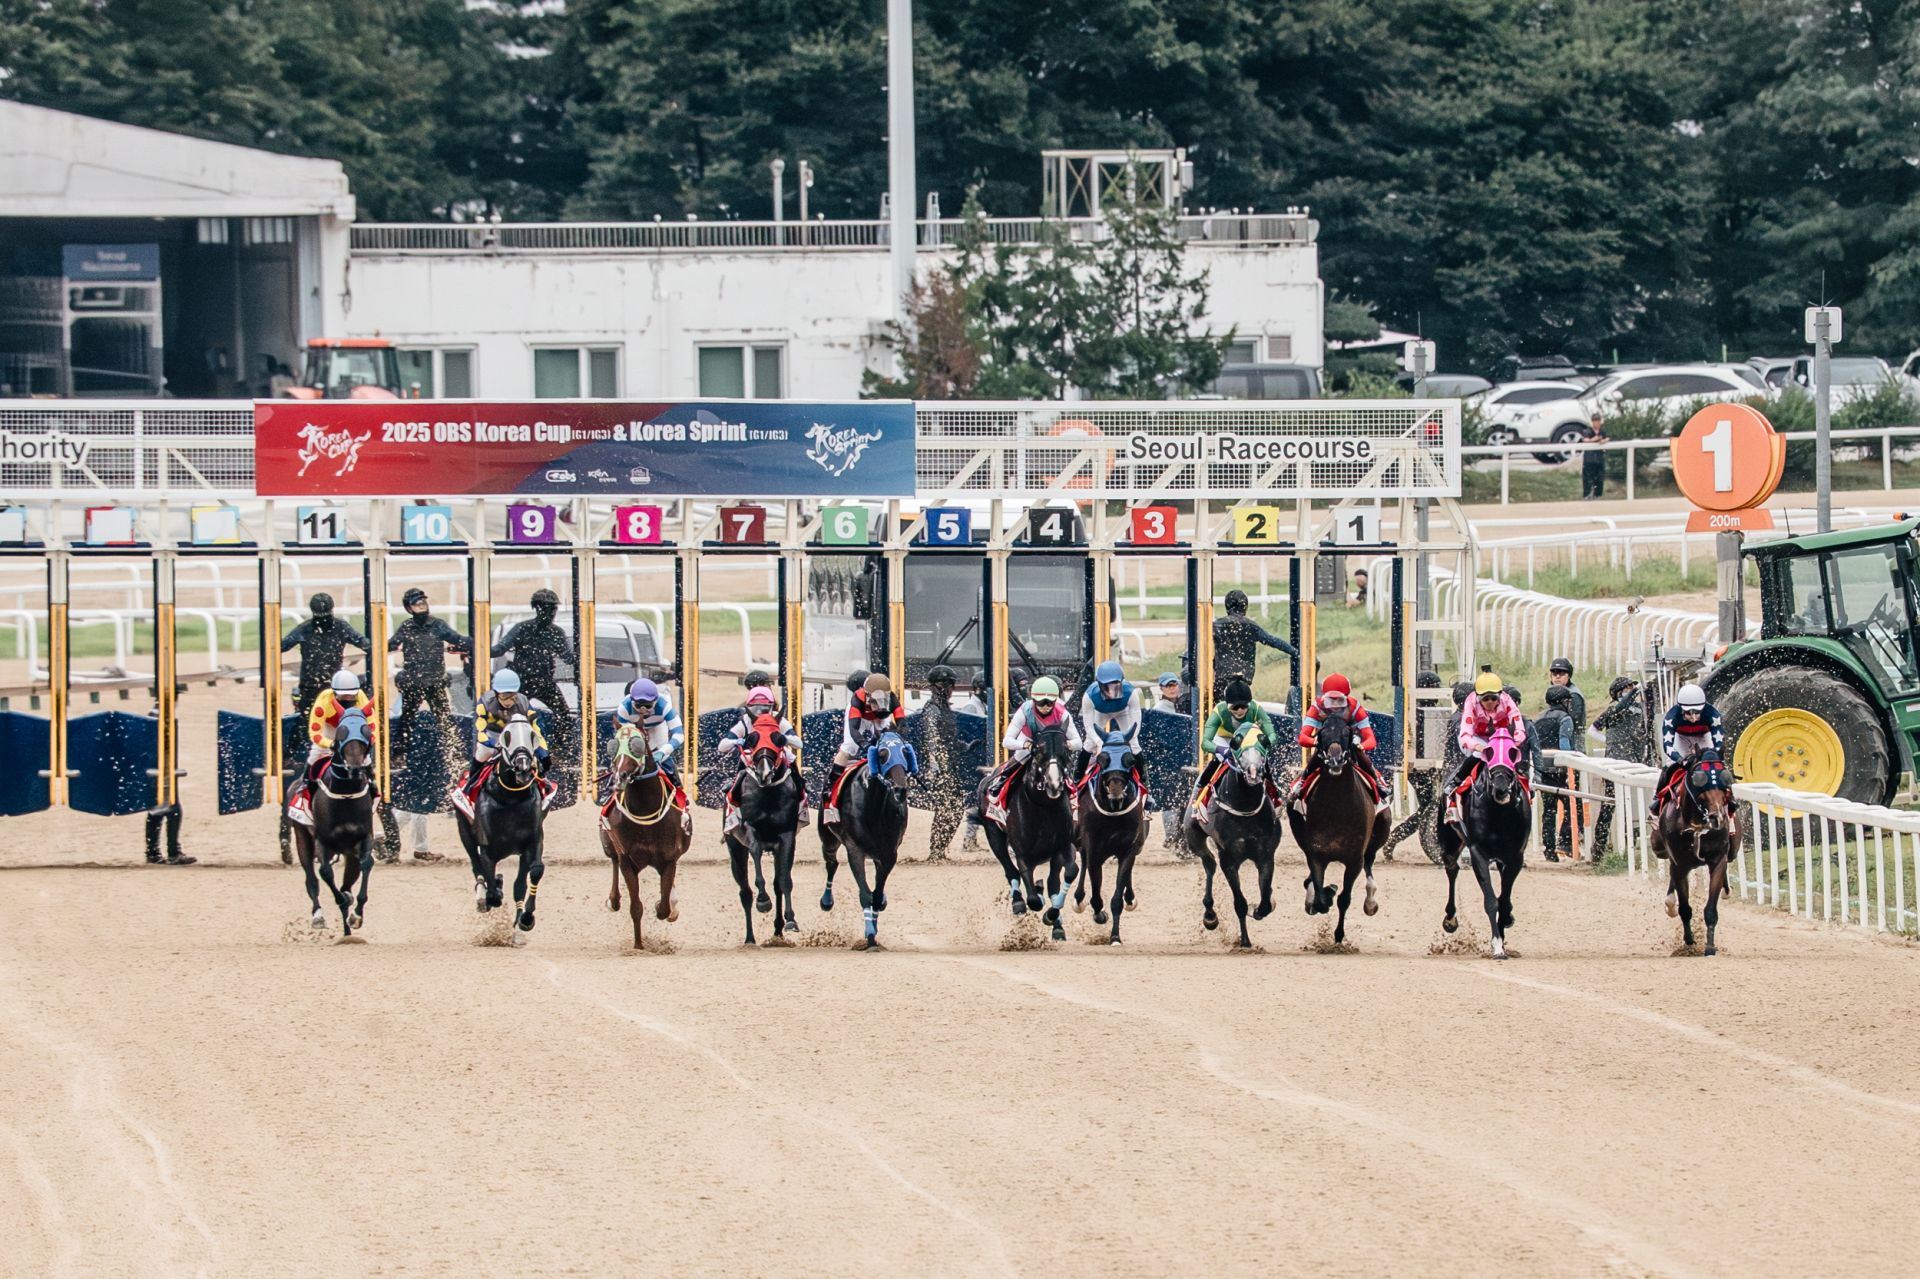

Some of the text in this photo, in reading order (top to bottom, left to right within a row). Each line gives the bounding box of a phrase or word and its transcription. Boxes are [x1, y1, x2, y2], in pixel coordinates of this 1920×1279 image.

[382, 421, 431, 443] 2025
[434, 421, 472, 443] OBS
[474, 421, 531, 442] Korea
[534, 421, 571, 444] Cup
[613, 424, 628, 442] &
[630, 421, 686, 442] Korea
[689, 420, 748, 443] Sprint
[2, 434, 87, 466] hority
[1131, 435, 1371, 461] Seoul Racecourse
[1701, 420, 1733, 492] 1
[302, 512, 337, 539] 11
[409, 512, 448, 540] 10
[521, 510, 546, 537] 9
[628, 511, 651, 539] 8
[732, 514, 755, 541] 7
[834, 511, 857, 539] 6
[937, 514, 960, 540] 5
[1038, 513, 1064, 541] 4
[1143, 511, 1166, 539] 3
[1245, 513, 1267, 539] 2
[1348, 515, 1365, 542] 1
[1709, 515, 1741, 527] 200m
